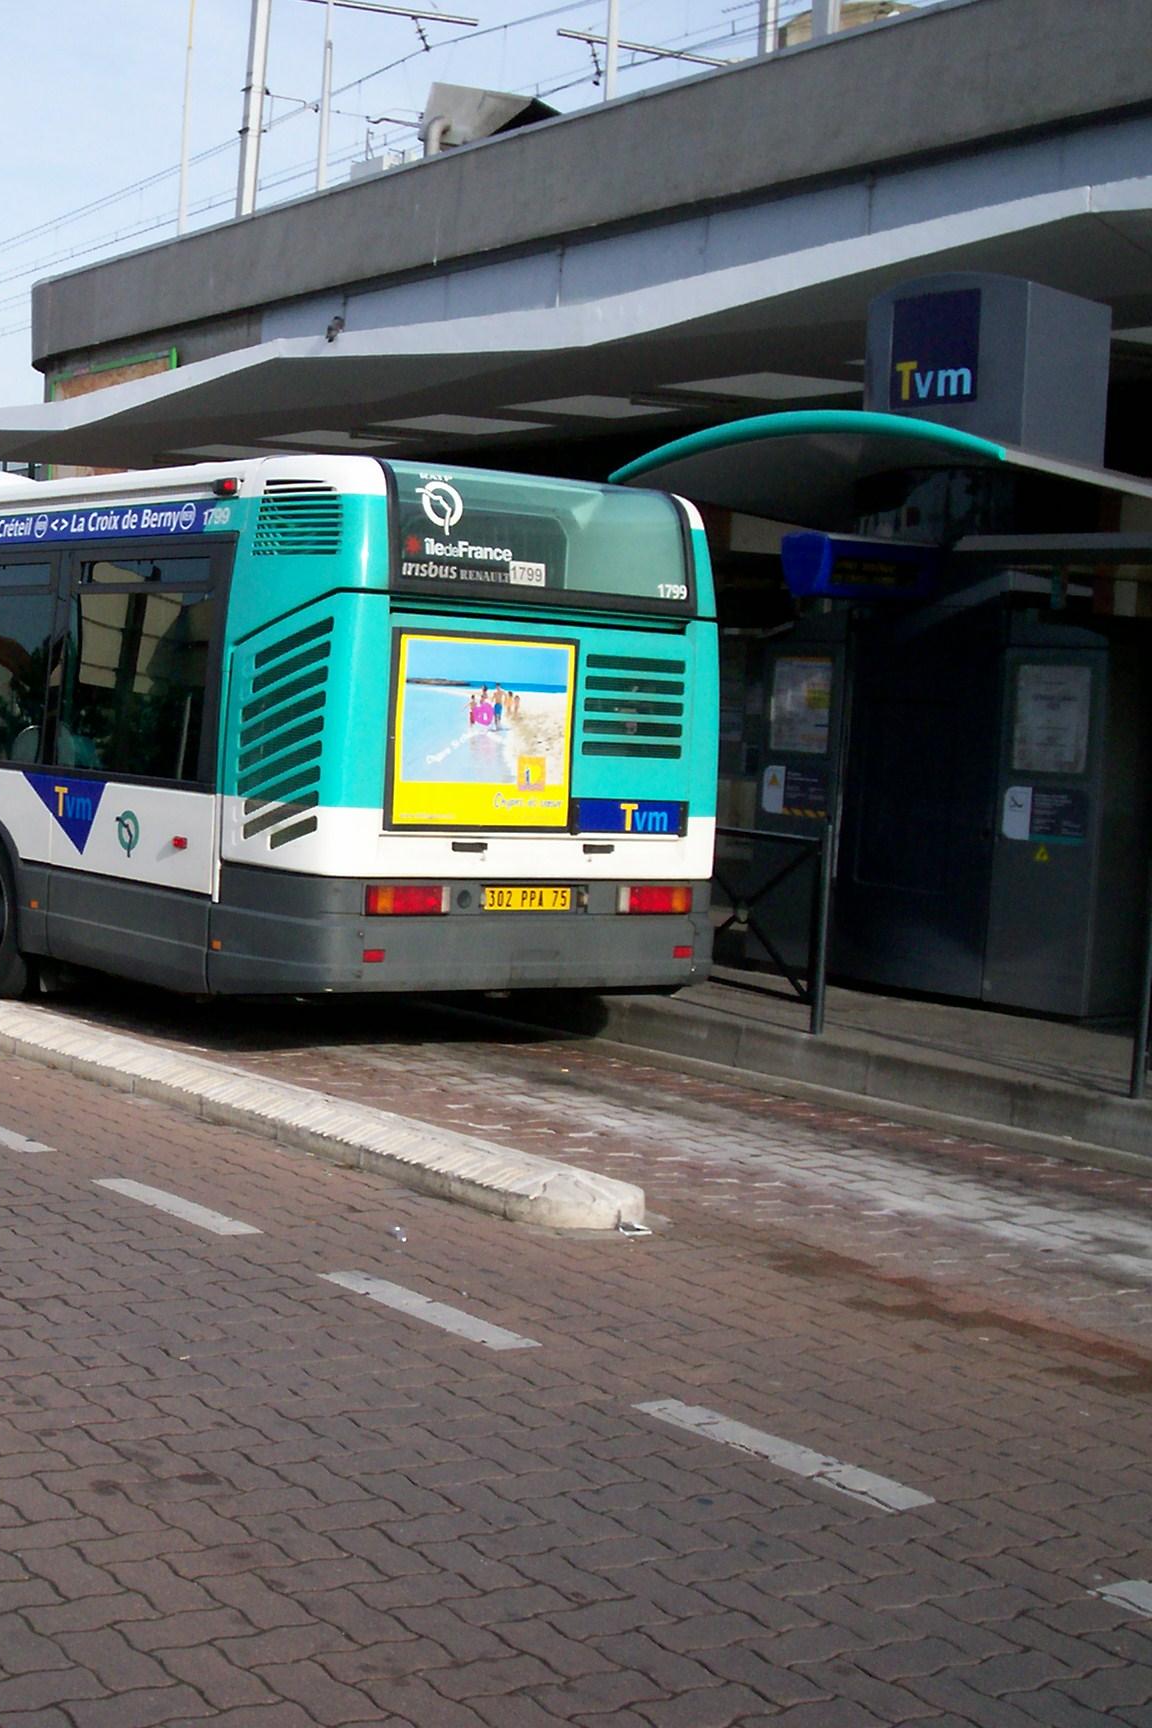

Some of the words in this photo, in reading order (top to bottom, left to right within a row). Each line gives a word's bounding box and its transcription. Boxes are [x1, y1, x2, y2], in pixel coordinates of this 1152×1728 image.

[896, 361, 972, 400] Tvm
[70, 514, 84, 533] La
[88, 510, 118, 532] Croix
[121, 511, 137, 529] de
[141, 509, 181, 532] Berny
[203, 507, 230, 525] 1799
[460, 569, 510, 583] RENAULT
[511, 565, 543, 583] 1799
[657, 583, 688, 600] 1799
[54, 786, 92, 820] Tvm
[620, 803, 668, 832] Tvm
[488, 890, 512, 908] 302
[521, 890, 544, 908] PPA
[553, 890, 568, 907] 75
